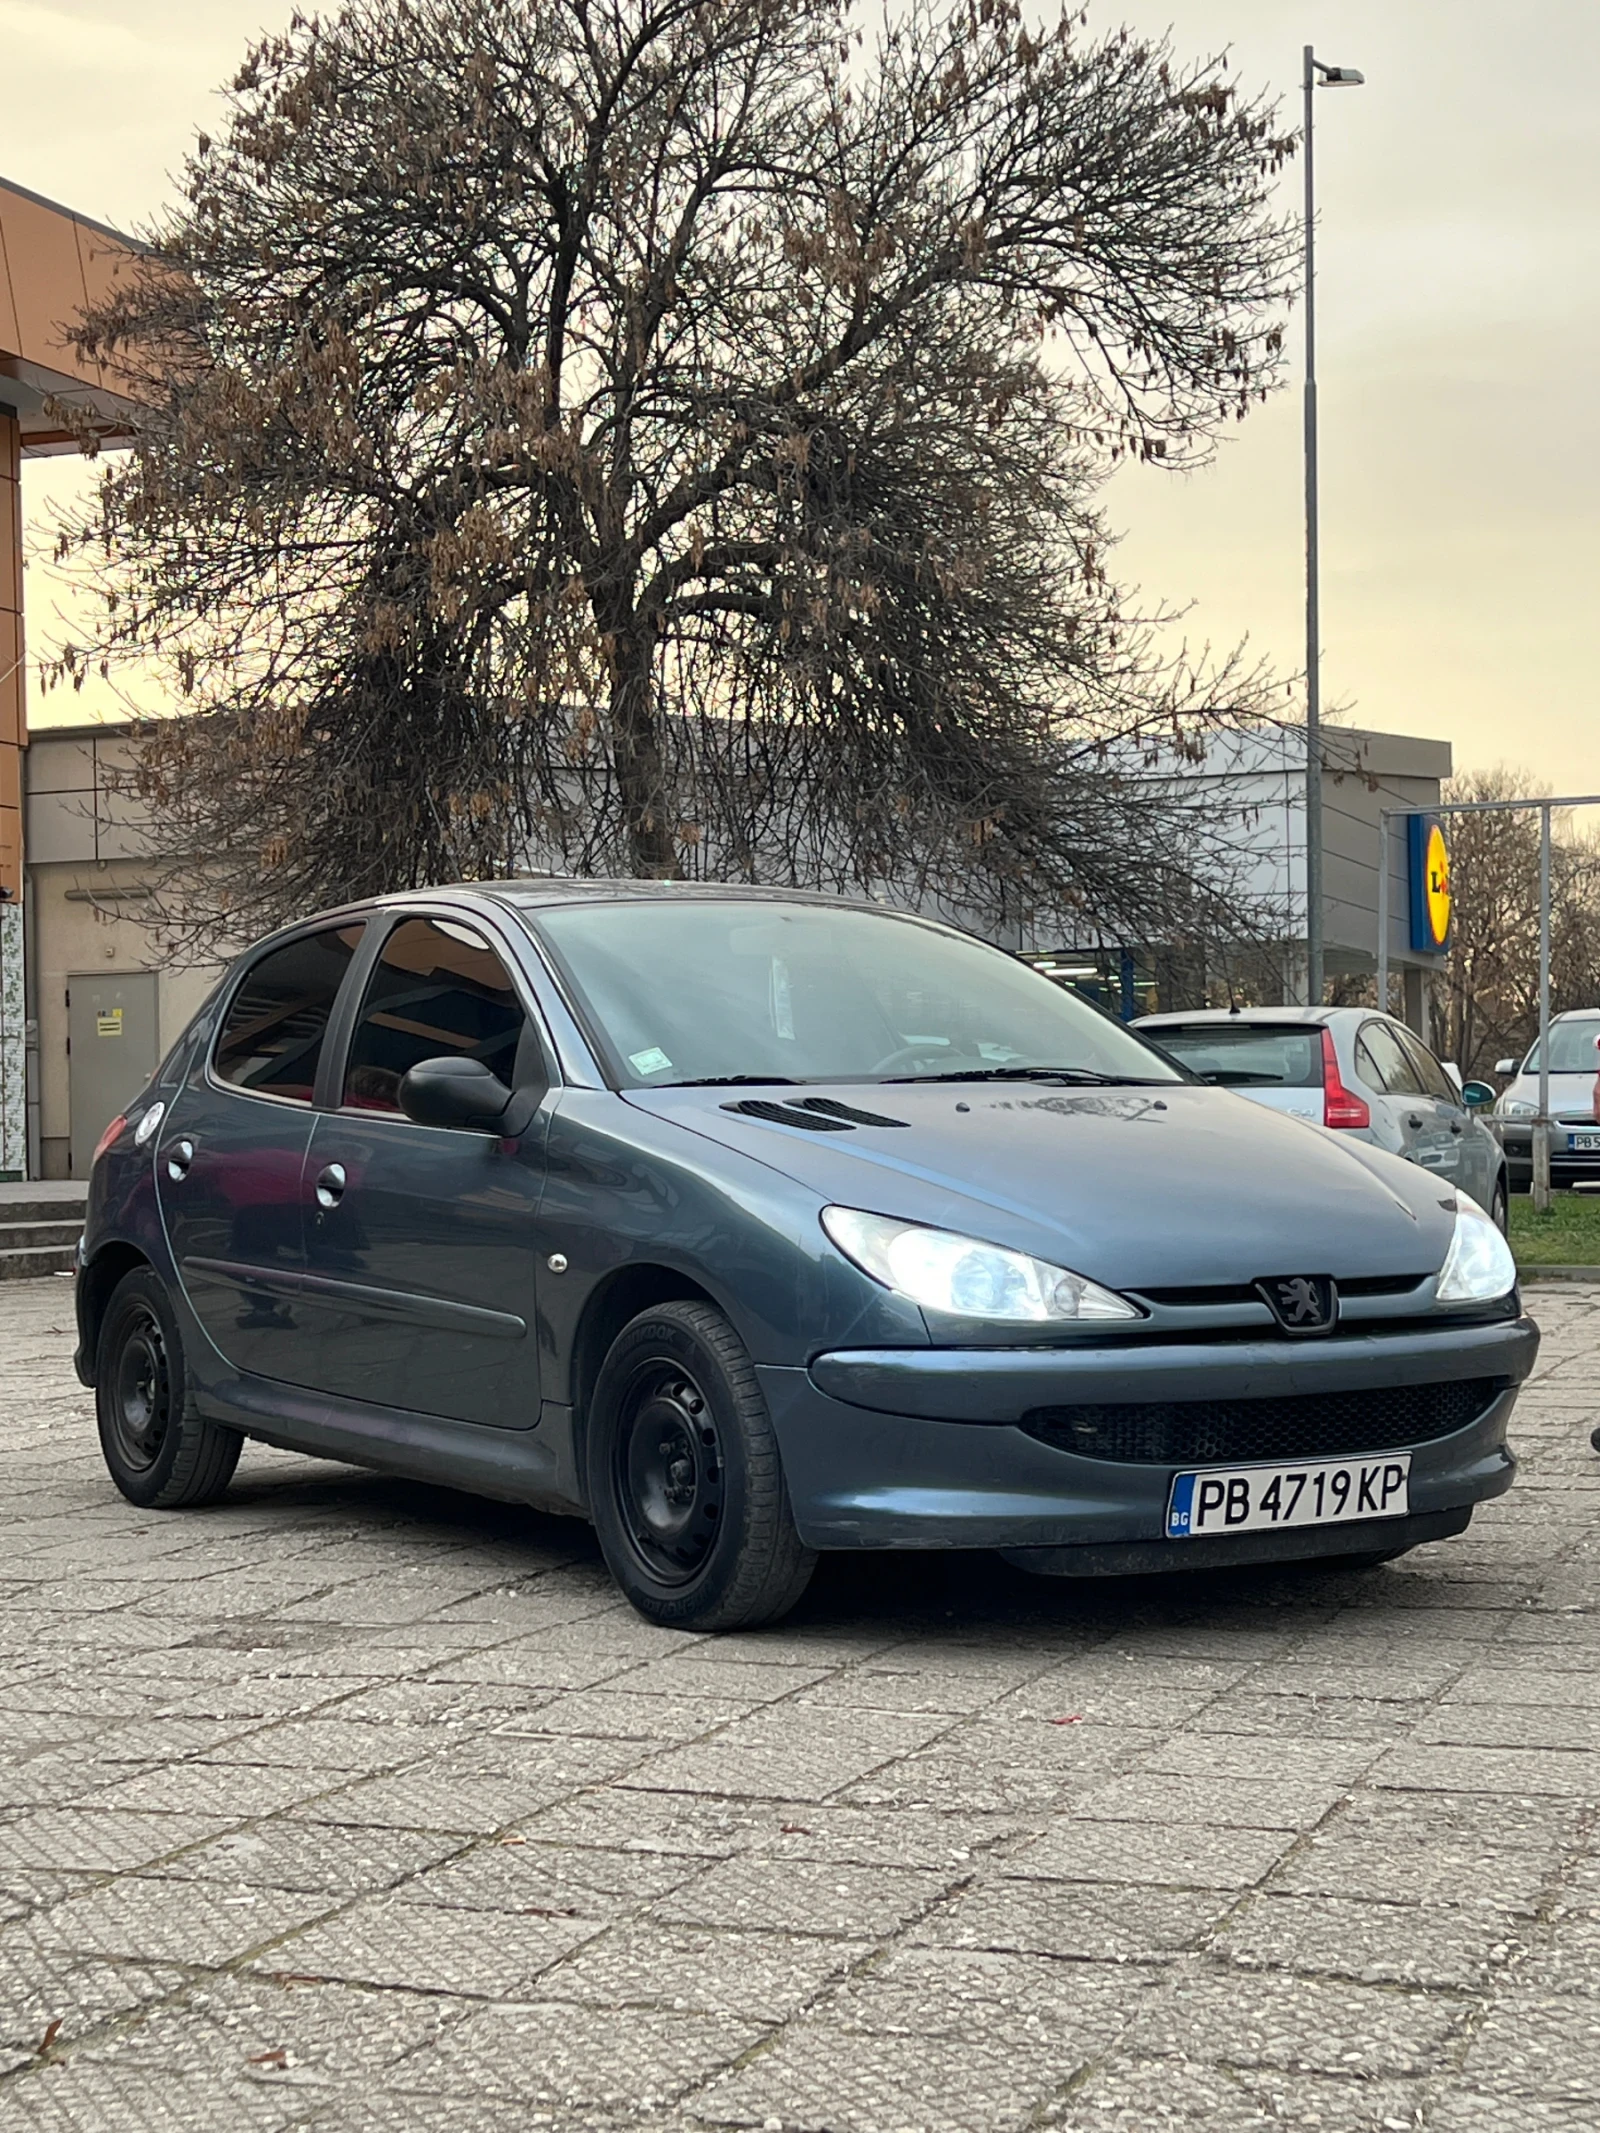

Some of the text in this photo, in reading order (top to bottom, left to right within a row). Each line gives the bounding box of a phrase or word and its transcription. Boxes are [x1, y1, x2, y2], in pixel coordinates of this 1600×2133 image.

[1576, 1136, 1592, 1148] PB
[1197, 1464, 1404, 1526] PB 4719 KP
[1171, 1512, 1189, 1527] BG
